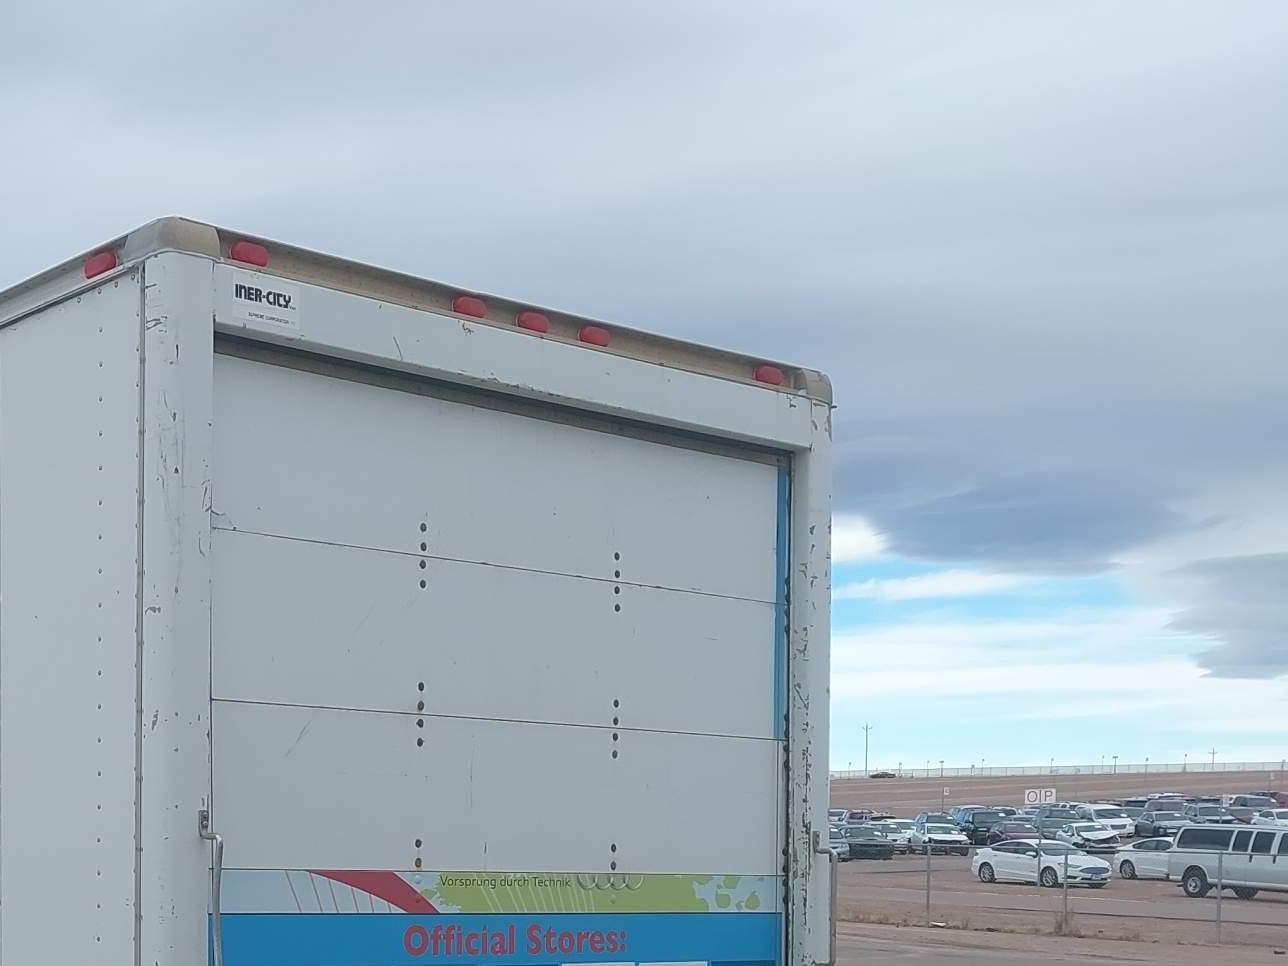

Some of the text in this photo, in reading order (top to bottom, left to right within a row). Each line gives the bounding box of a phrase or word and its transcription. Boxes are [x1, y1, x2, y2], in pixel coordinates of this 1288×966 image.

[235, 283, 292, 309] INER-CITY
[440, 875, 571, 889] Vorsprung durch Technik
[403, 922, 627, 956] Official Stores:
